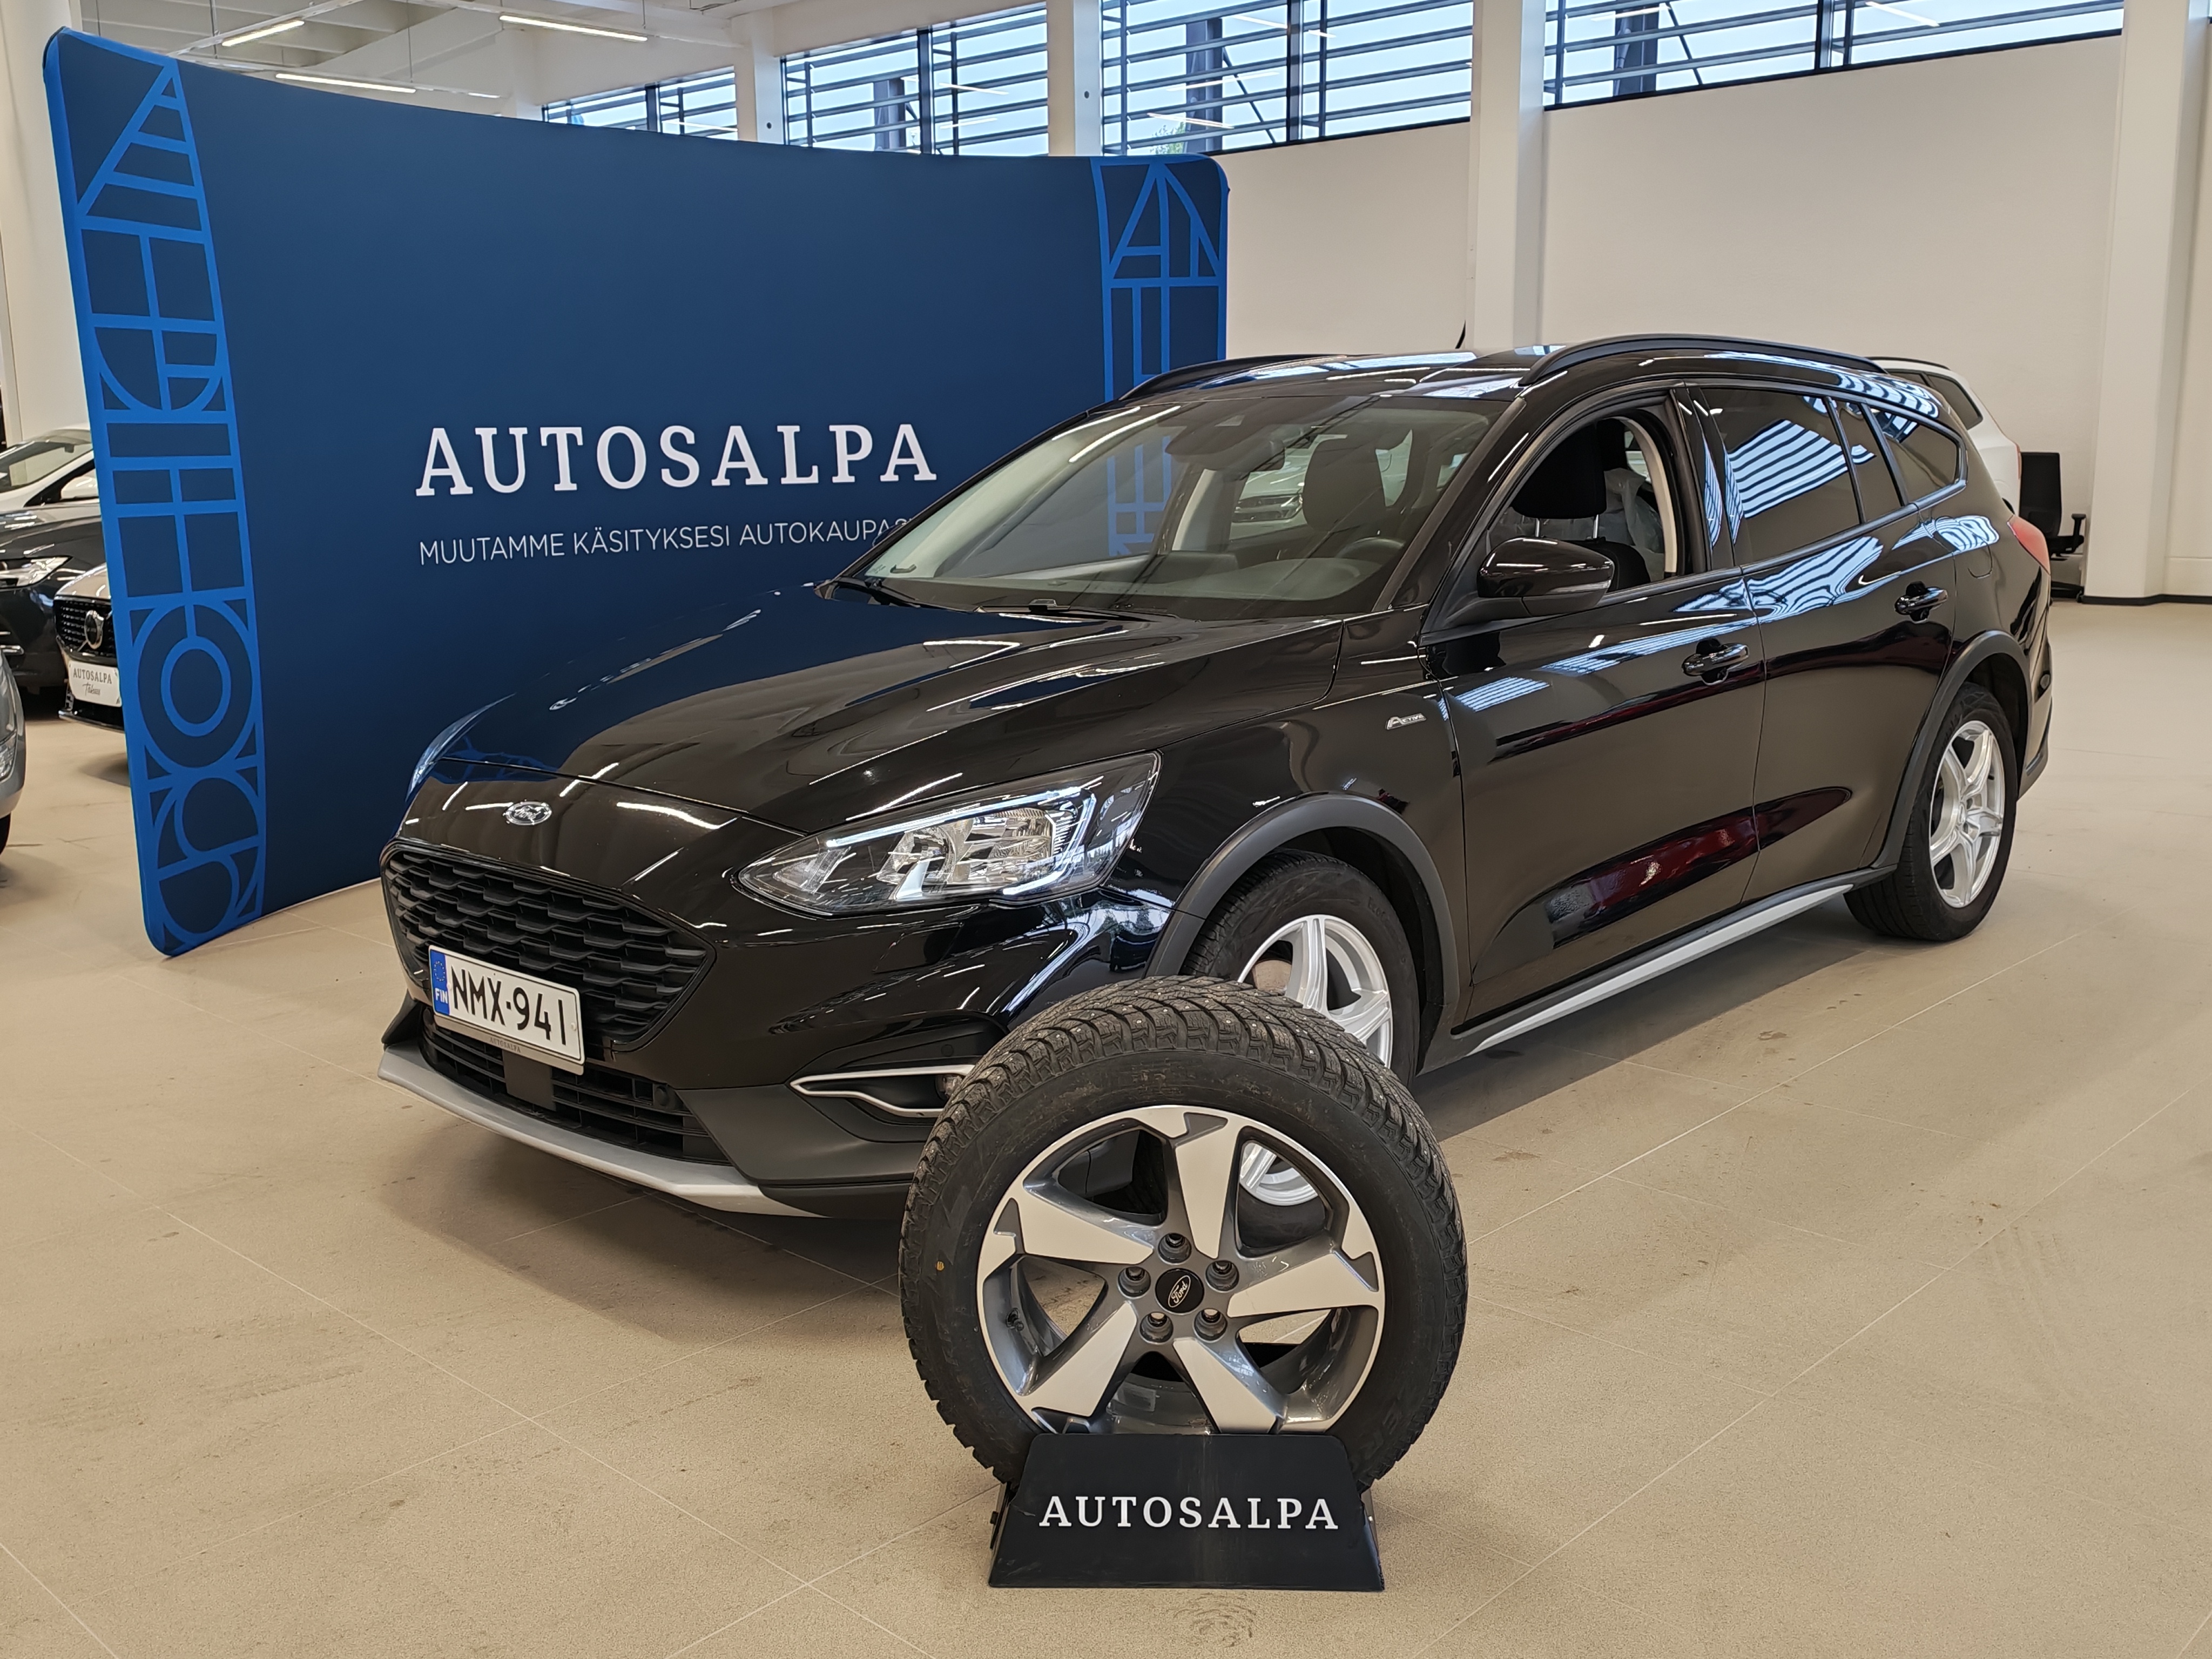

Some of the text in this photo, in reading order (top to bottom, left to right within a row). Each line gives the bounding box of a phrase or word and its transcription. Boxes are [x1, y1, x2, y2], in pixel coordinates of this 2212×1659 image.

[415, 424, 936, 496] AUTOSALPA
[420, 533, 565, 565] MUUTAMME
[573, 525, 730, 555] KÄSITYKSESI
[73, 667, 112, 685] AUTOSALPA
[435, 988, 449, 1004] FIN
[451, 965, 567, 1046] NMX-941
[1171, 1280, 1188, 1304] Ford
[1038, 1496, 1339, 1529] AUTOSALPA
